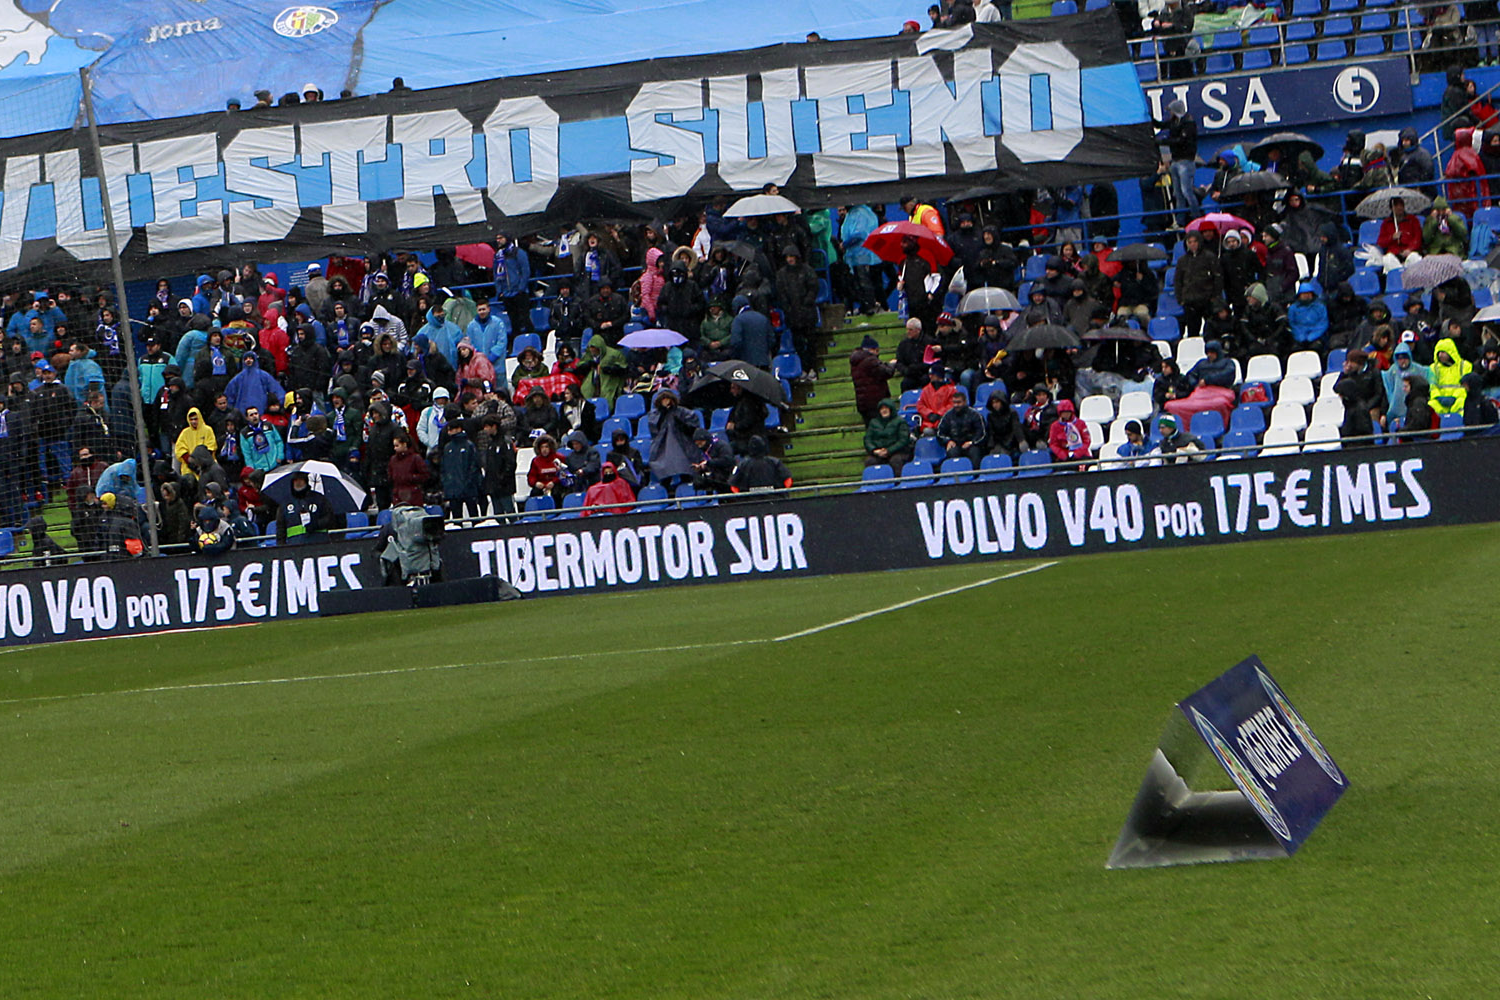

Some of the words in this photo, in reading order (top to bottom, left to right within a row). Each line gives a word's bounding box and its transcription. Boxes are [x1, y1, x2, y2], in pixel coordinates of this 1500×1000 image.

[626, 23, 1084, 202] SUEÑO
[471, 521, 717, 593] TIBERMOTOR
[726, 514, 807, 575] SUR
[916, 491, 1047, 559] VOLVO
[1061, 482, 1144, 549] V40
[1155, 502, 1204, 539] POR
[1209, 458, 1432, 534] 175€/MES
[42, 575, 118, 637] V40
[126, 593, 170, 629] POR
